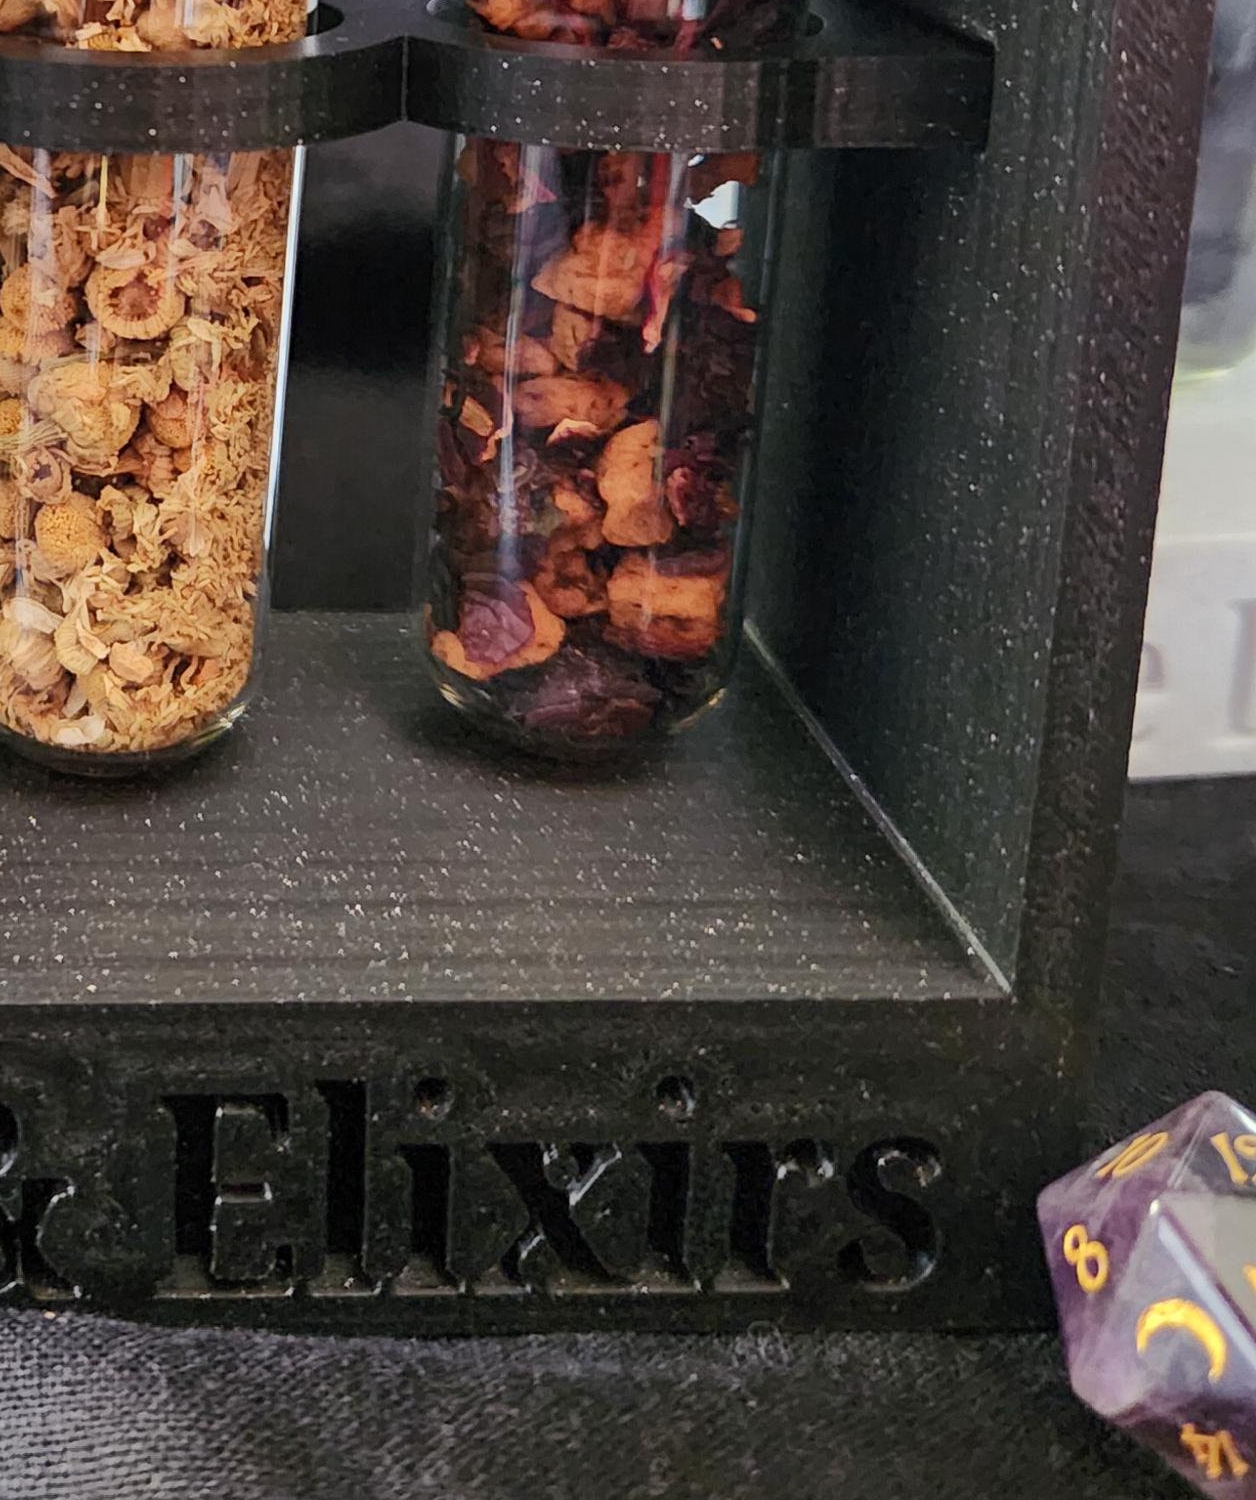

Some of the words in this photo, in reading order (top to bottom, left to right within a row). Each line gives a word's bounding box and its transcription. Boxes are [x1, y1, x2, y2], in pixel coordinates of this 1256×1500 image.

[150, 1074, 944, 1300] Elixirs
[1095, 1131, 1169, 1179] 10
[1063, 1223, 1110, 1294] 8
